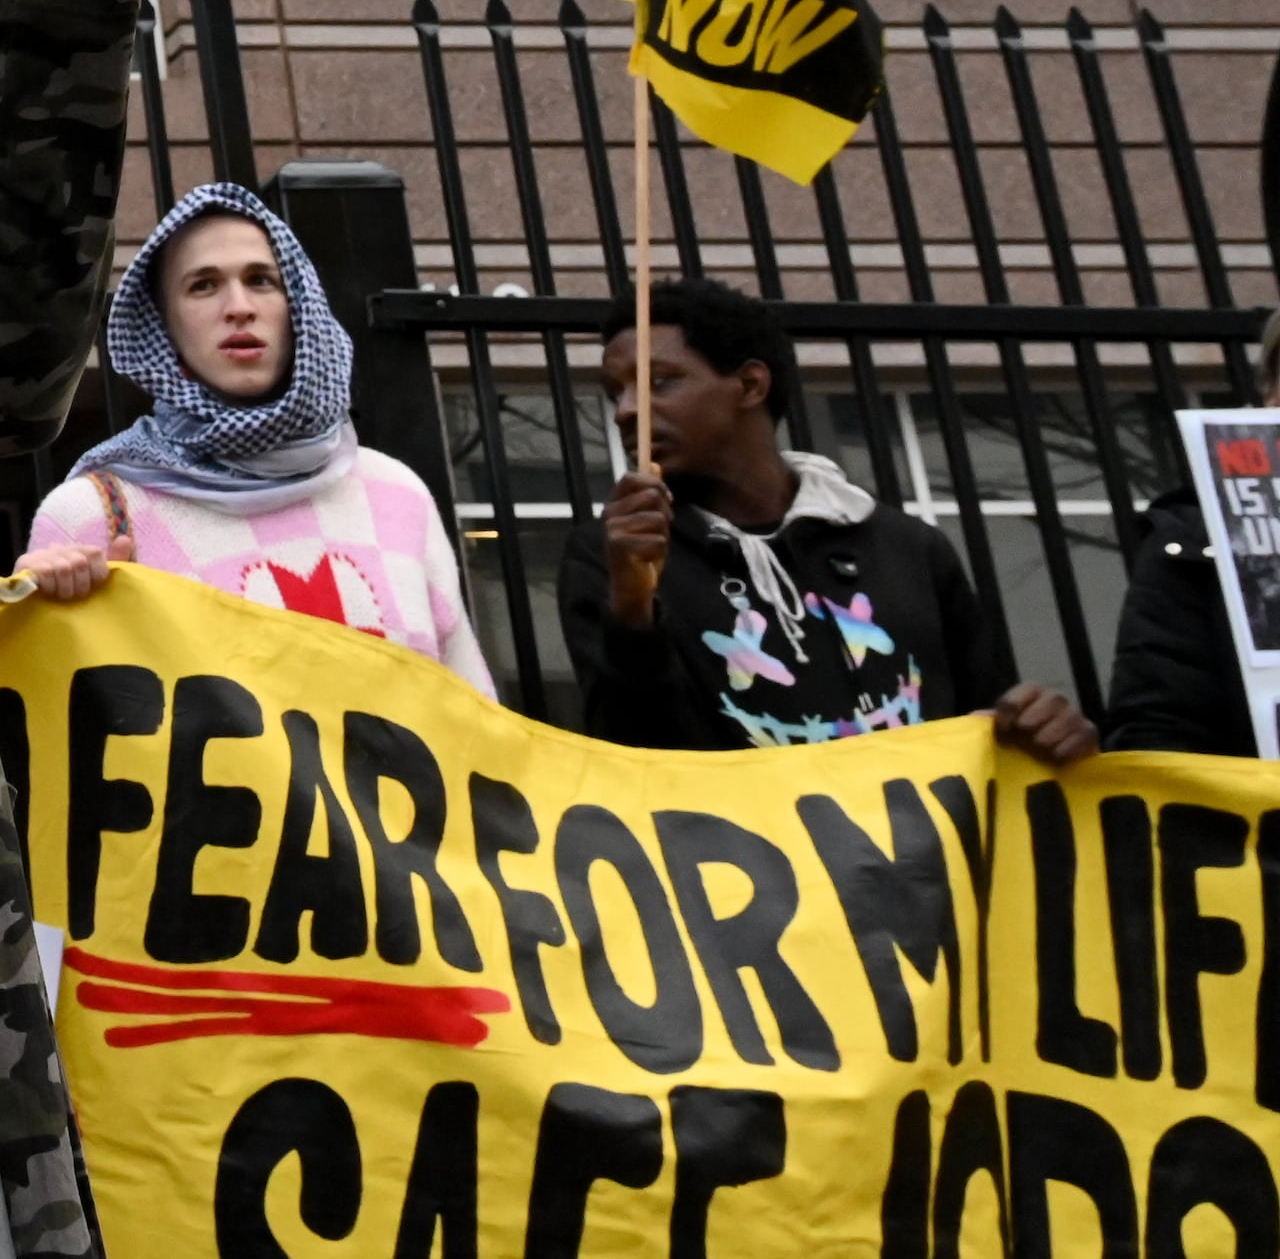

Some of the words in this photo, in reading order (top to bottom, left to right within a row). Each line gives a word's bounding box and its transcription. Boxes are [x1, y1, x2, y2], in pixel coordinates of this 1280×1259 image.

[1223, 478, 1266, 515] IS
[67, 663, 482, 973] FEAR
[468, 771, 841, 1074] FOR
[795, 775, 997, 1066] MY
